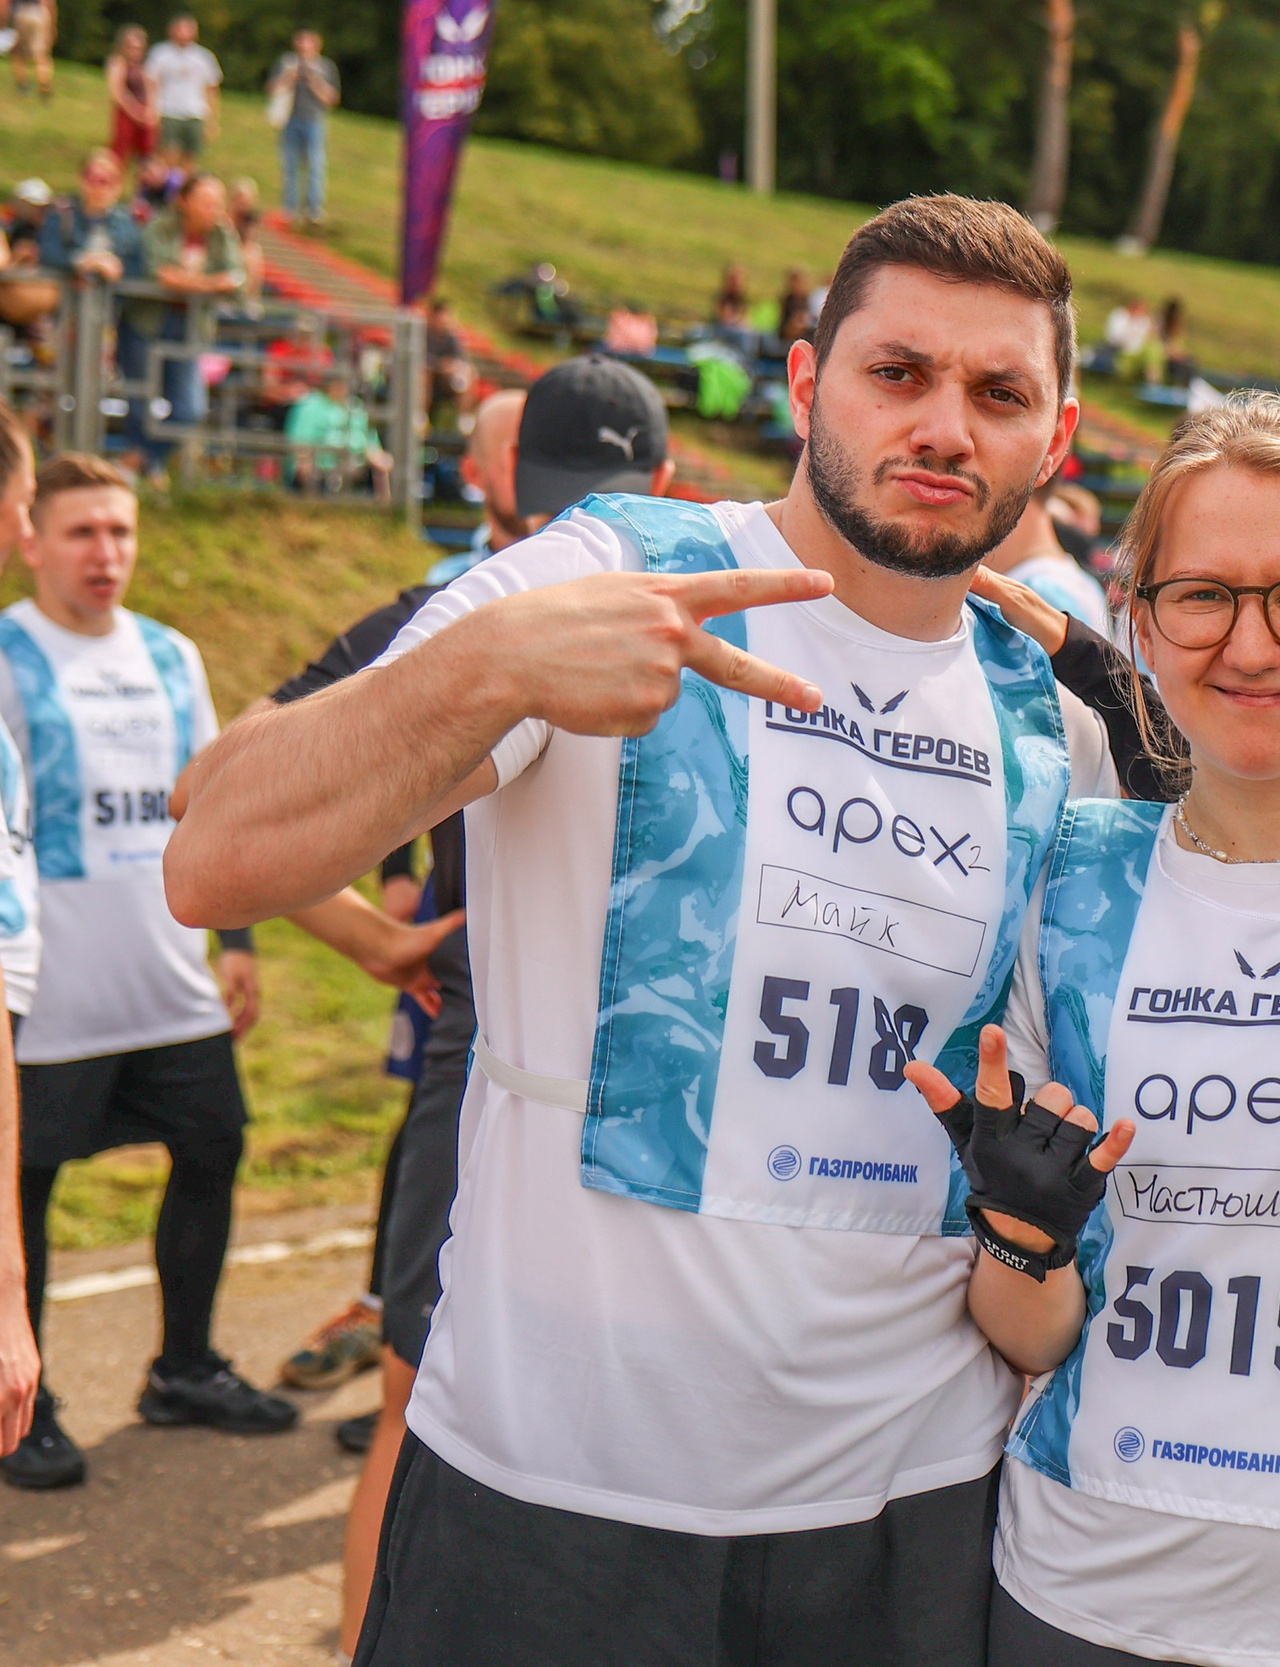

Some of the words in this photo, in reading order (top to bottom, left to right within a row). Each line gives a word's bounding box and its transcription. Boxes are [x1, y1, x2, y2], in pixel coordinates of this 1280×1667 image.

[874, 728, 991, 775] ГЕРОЕВ
[780, 880, 900, 947] Майк
[1129, 987, 1237, 1015] ГОНКА
[809, 1157, 918, 1183] ГАЗПРОМБАНК
[984, 1237, 1030, 1266] SPORT
